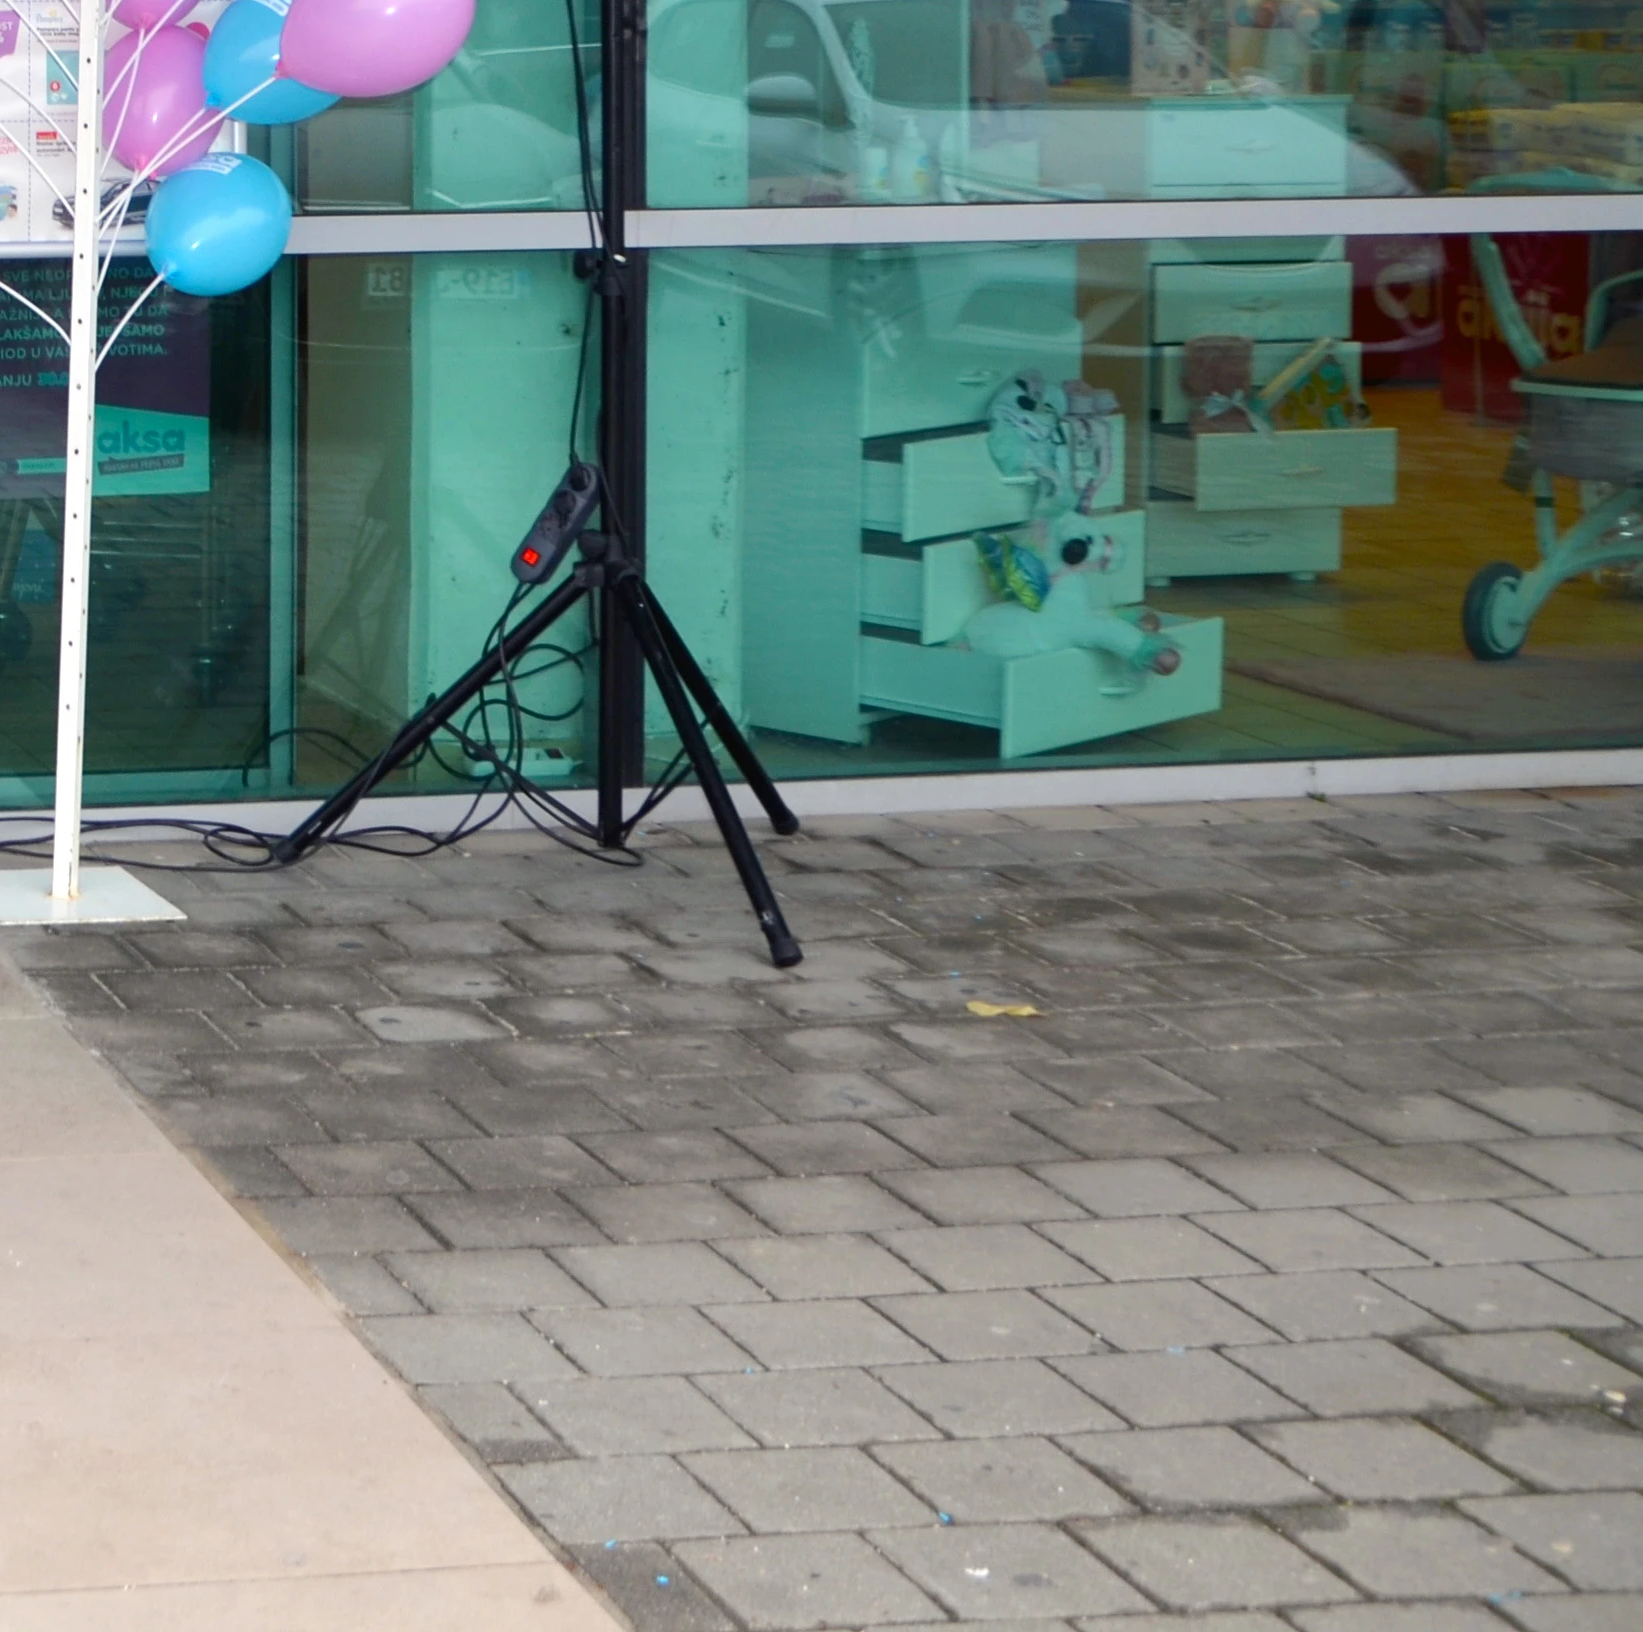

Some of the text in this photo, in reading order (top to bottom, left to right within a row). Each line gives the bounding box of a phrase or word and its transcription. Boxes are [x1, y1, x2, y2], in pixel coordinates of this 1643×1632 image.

[3, 269, 30, 283] SVE
[31, 347, 41, 359] U
[98, 419, 186, 453] aksa
